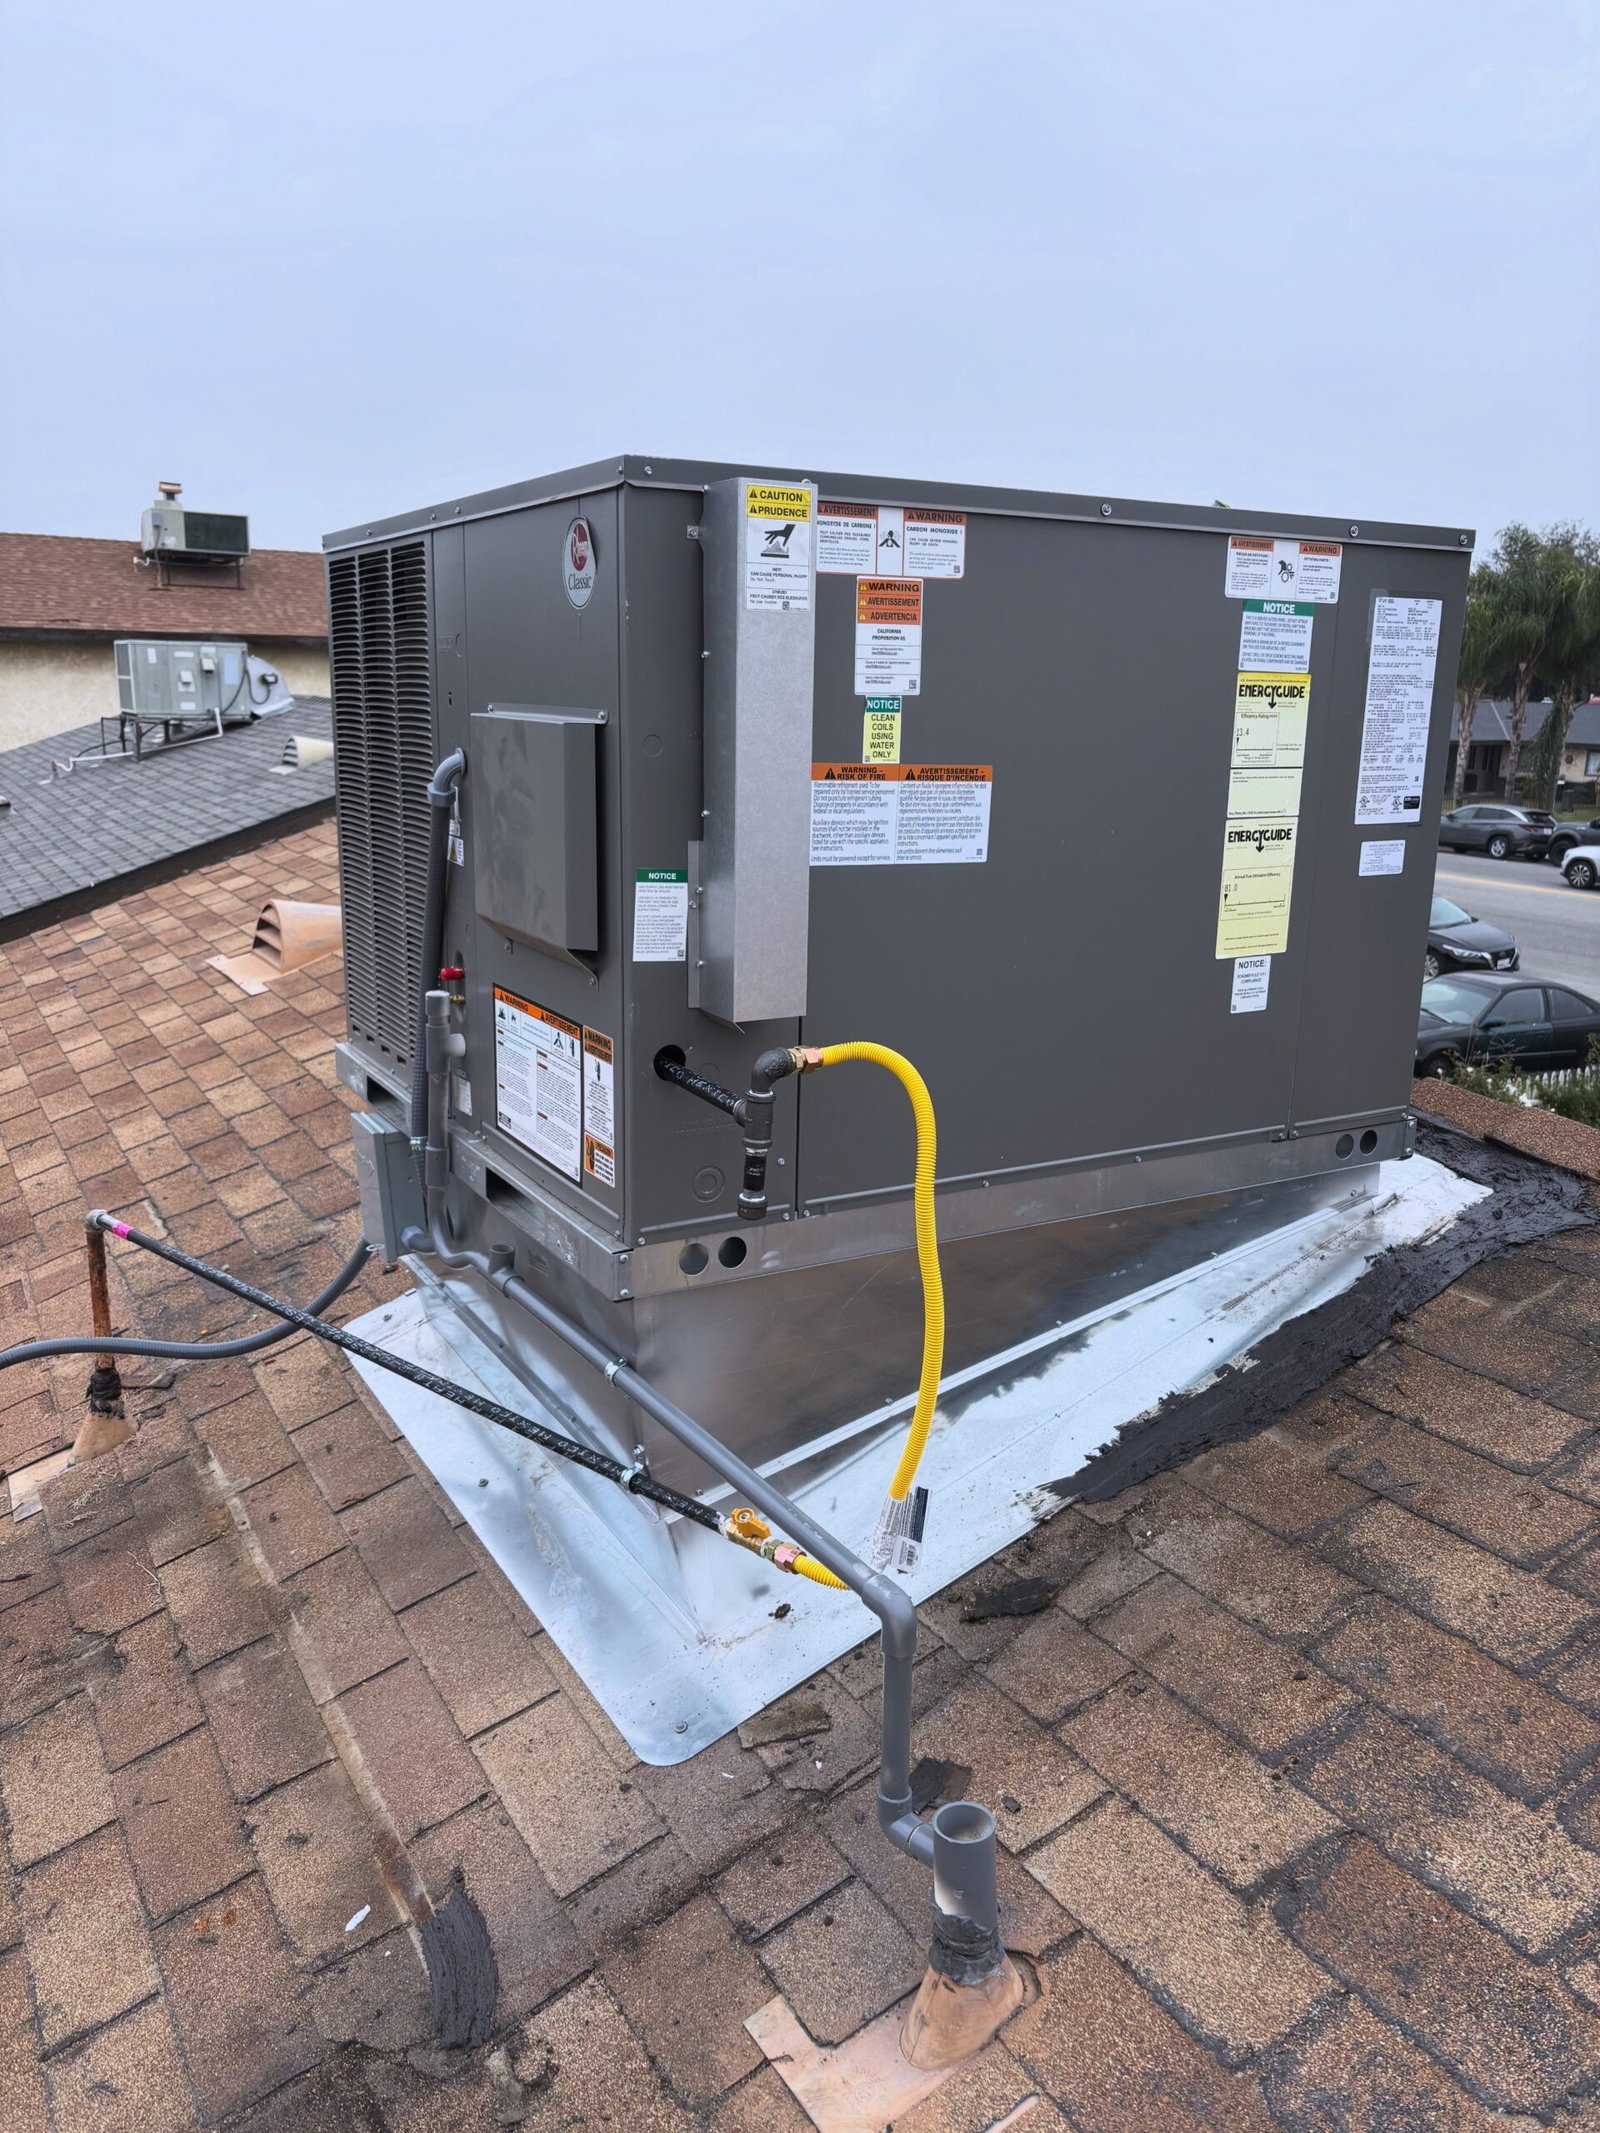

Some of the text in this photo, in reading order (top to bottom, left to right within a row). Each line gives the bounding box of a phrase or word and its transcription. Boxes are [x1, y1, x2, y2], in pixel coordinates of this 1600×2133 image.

[760, 490, 803, 502] CAUTION
[758, 506, 807, 518] PRUDENCE
[823, 504, 875, 517] AVERTISSEMENT
[916, 511, 963, 523] WARNING
[1308, 544, 1337, 554] WARNING
[568, 574, 592, 590] Classic
[868, 582, 920, 592] WARNING
[868, 597, 919, 606] AVERTISSEMENT
[1263, 602, 1296, 614] NOTICE
[870, 612, 917, 621] ADVERTENCIA
[1239, 684, 1305, 699] ENERGYGUIDE
[868, 700, 900, 709] NOTICE
[1236, 728, 1250, 736] 13.4
[1228, 828, 1292, 843] ENERGYGUIDE
[648, 872, 676, 880] NOTICE
[1224, 883, 1238, 892] 81.0
[1238, 960, 1266, 969] NOTICE:
[504, 994, 528, 1012] WARNING
[545, 1012, 578, 1036] AVERTISSEMENT
